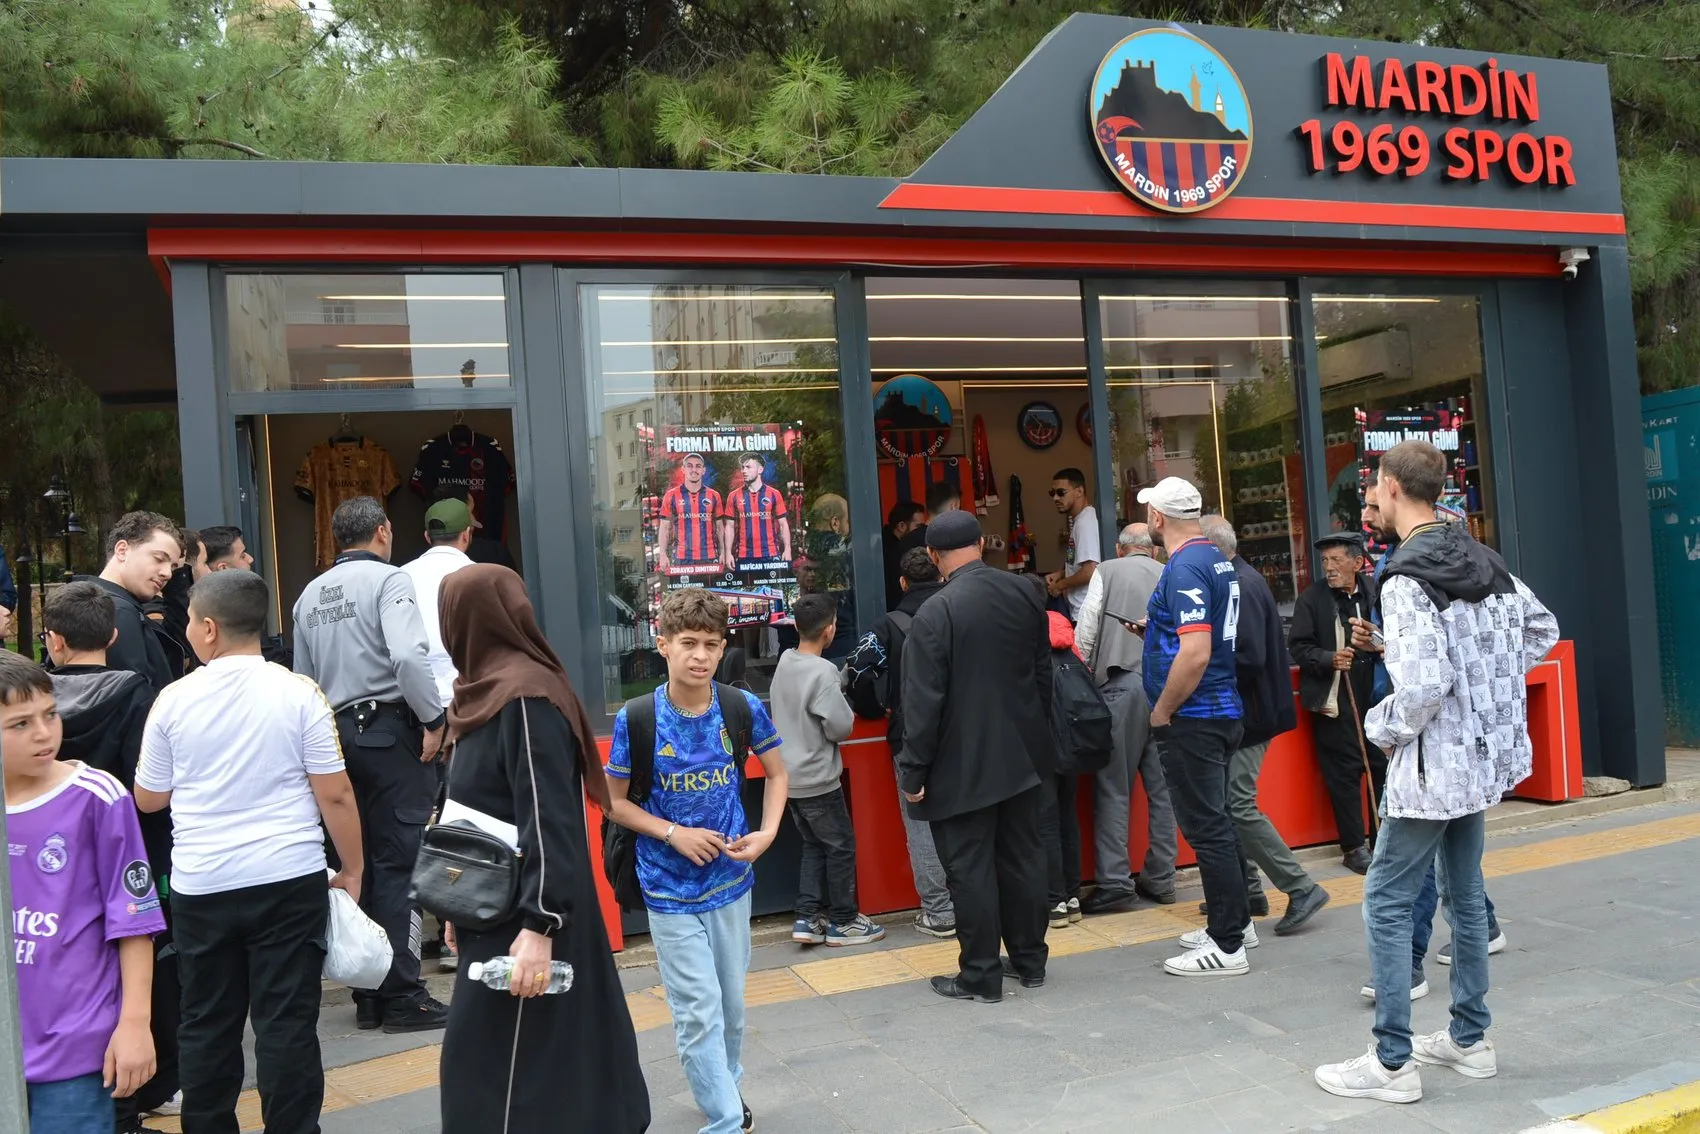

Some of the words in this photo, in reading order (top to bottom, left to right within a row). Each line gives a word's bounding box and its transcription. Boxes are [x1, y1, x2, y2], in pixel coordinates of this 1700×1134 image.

[1324, 52, 1539, 122] MARDİN
[1301, 118, 1430, 177] 1969
[1447, 128, 1576, 187] SPOR
[1173, 186, 1205, 203] 1969
[1205, 156, 1237, 194] SPOR
[666, 436, 711, 452] FORMA
[712, 434, 744, 452] İMZA
[745, 433, 777, 451] GÜNÜ
[927, 435, 945, 456] SPOR
[1363, 431, 1402, 451] FORMA
[1432, 428, 1459, 451] GÜNÜ
[319, 584, 344, 605] ÖZEL
[306, 599, 357, 628] GÜVENLİK
[659, 761, 735, 792] VERSAC
